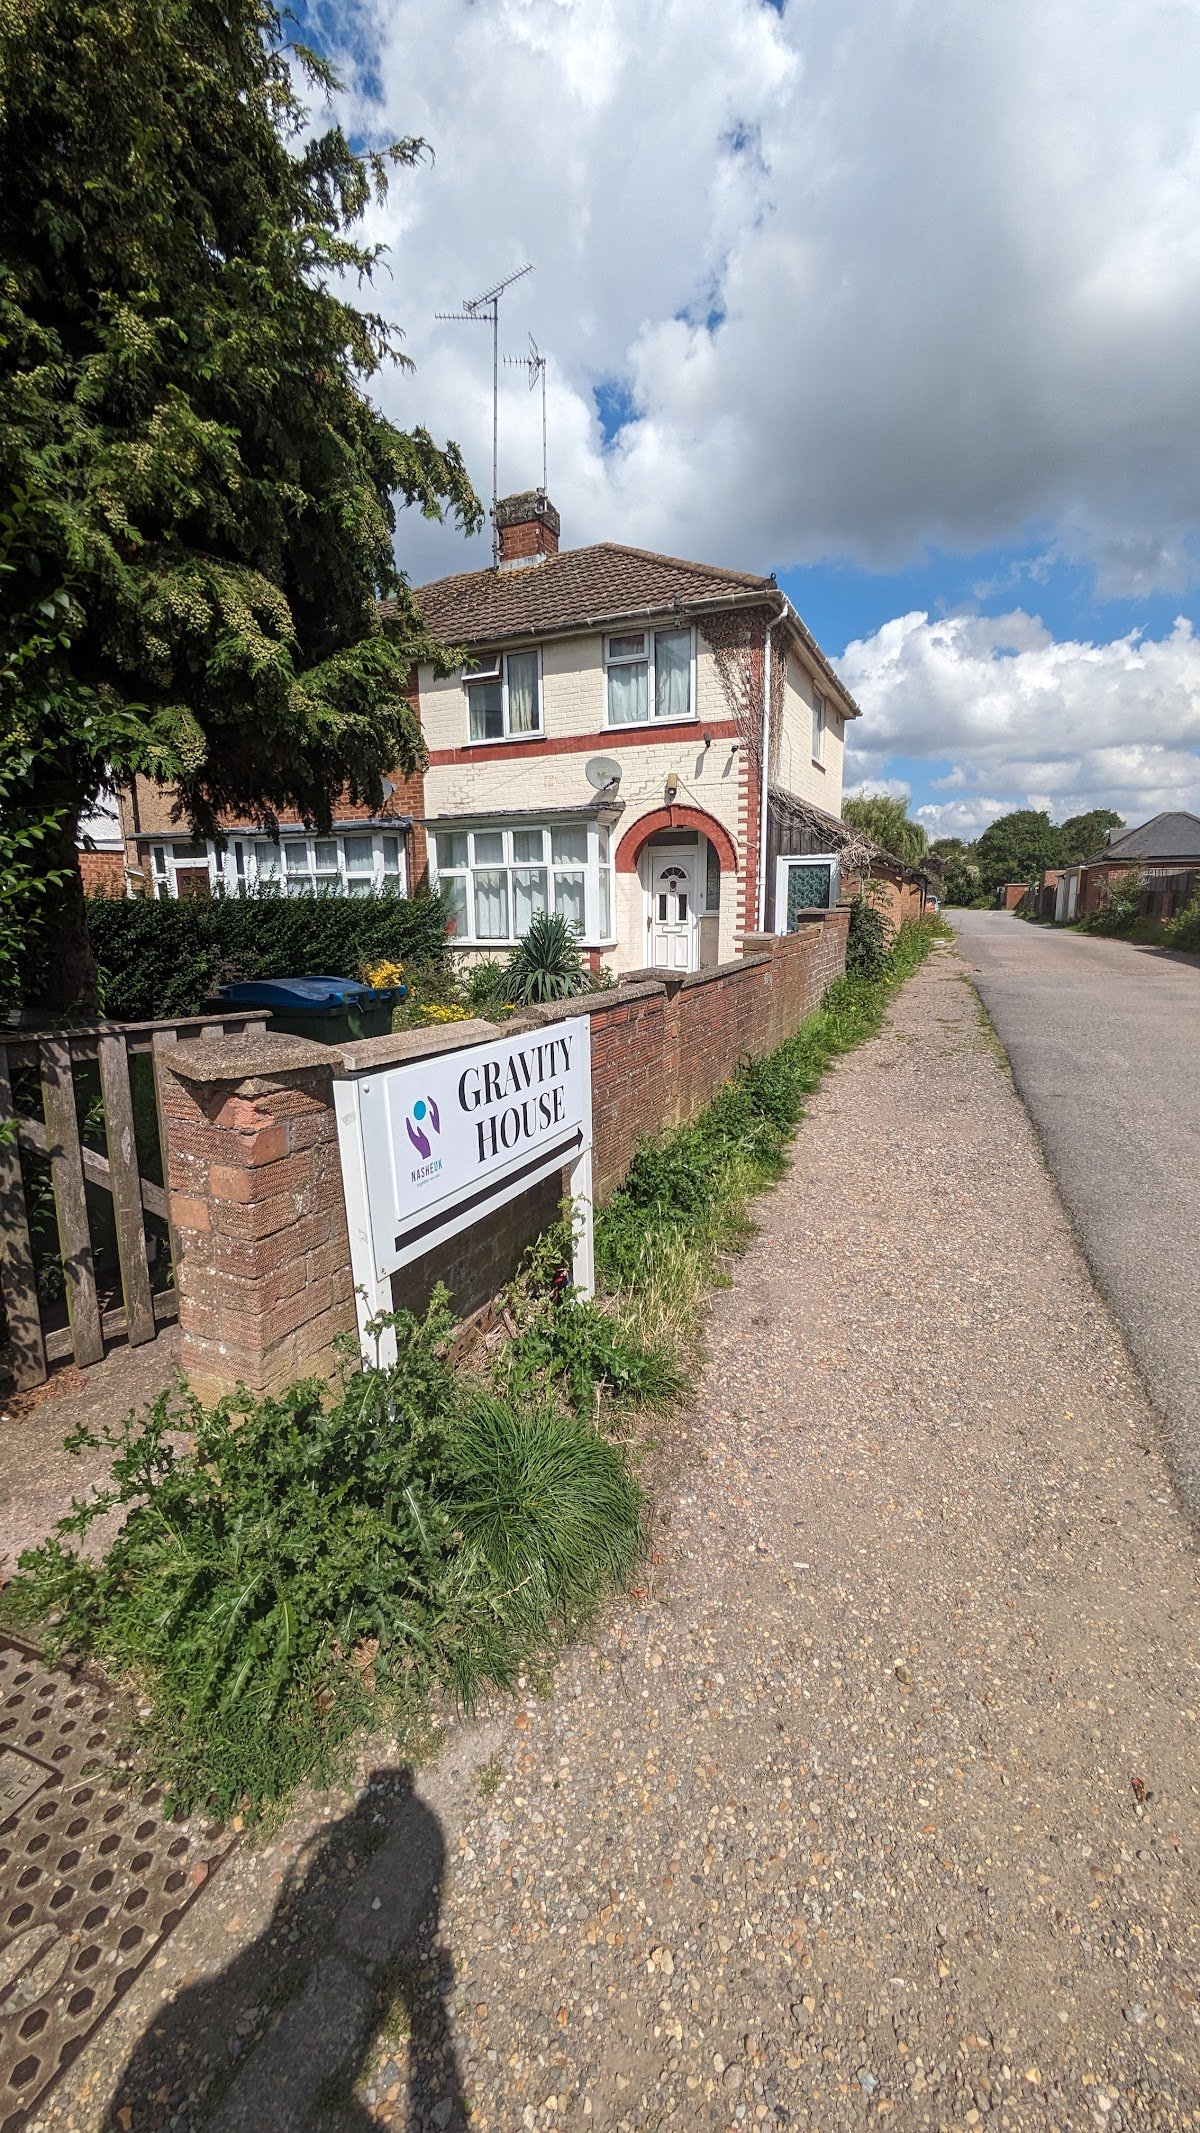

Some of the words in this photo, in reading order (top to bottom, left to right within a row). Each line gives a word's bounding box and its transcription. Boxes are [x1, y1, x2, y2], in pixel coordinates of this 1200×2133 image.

[458, 1036, 573, 1112] GRAVITY
[475, 1086, 565, 1164] HOUSE
[1, 1774, 35, 1804] ER
